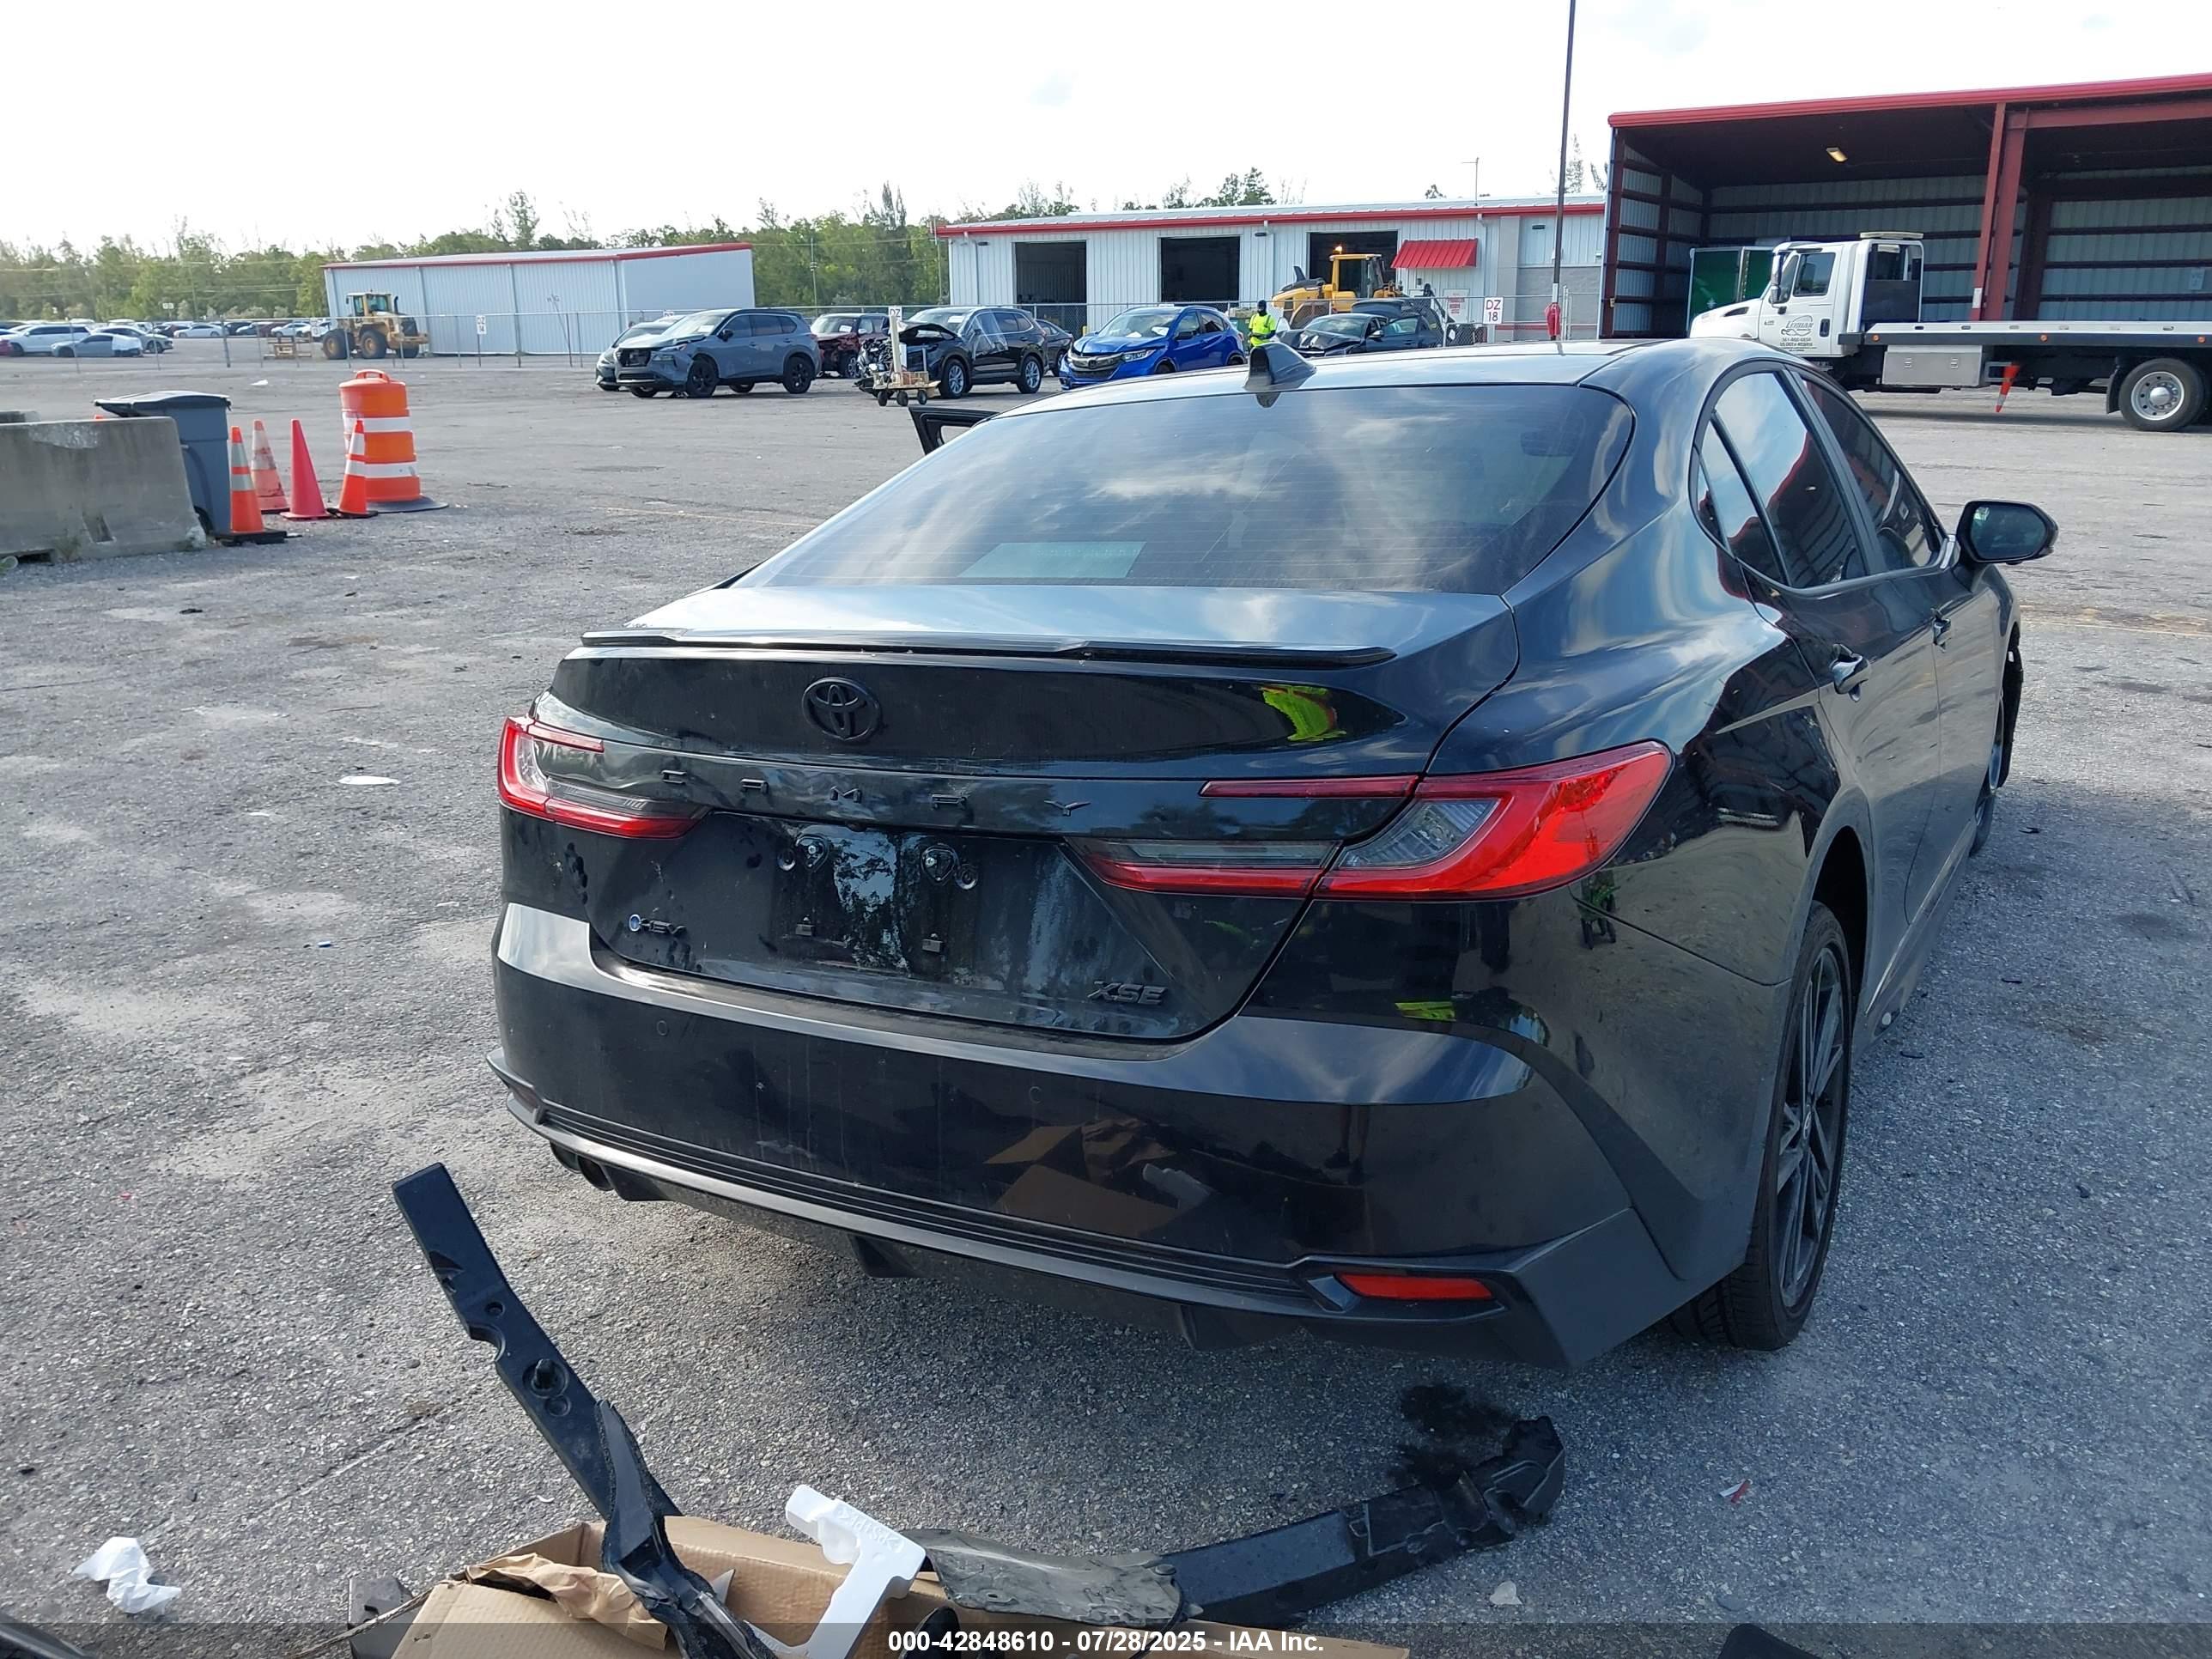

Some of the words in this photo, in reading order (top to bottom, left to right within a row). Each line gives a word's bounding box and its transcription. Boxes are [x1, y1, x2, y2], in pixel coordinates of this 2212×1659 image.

[1486, 300, 1501, 310] DZ
[1488, 312, 1498, 322] 18
[660, 769, 1091, 817] CAMRY
[1086, 981, 1167, 1005] XSE
